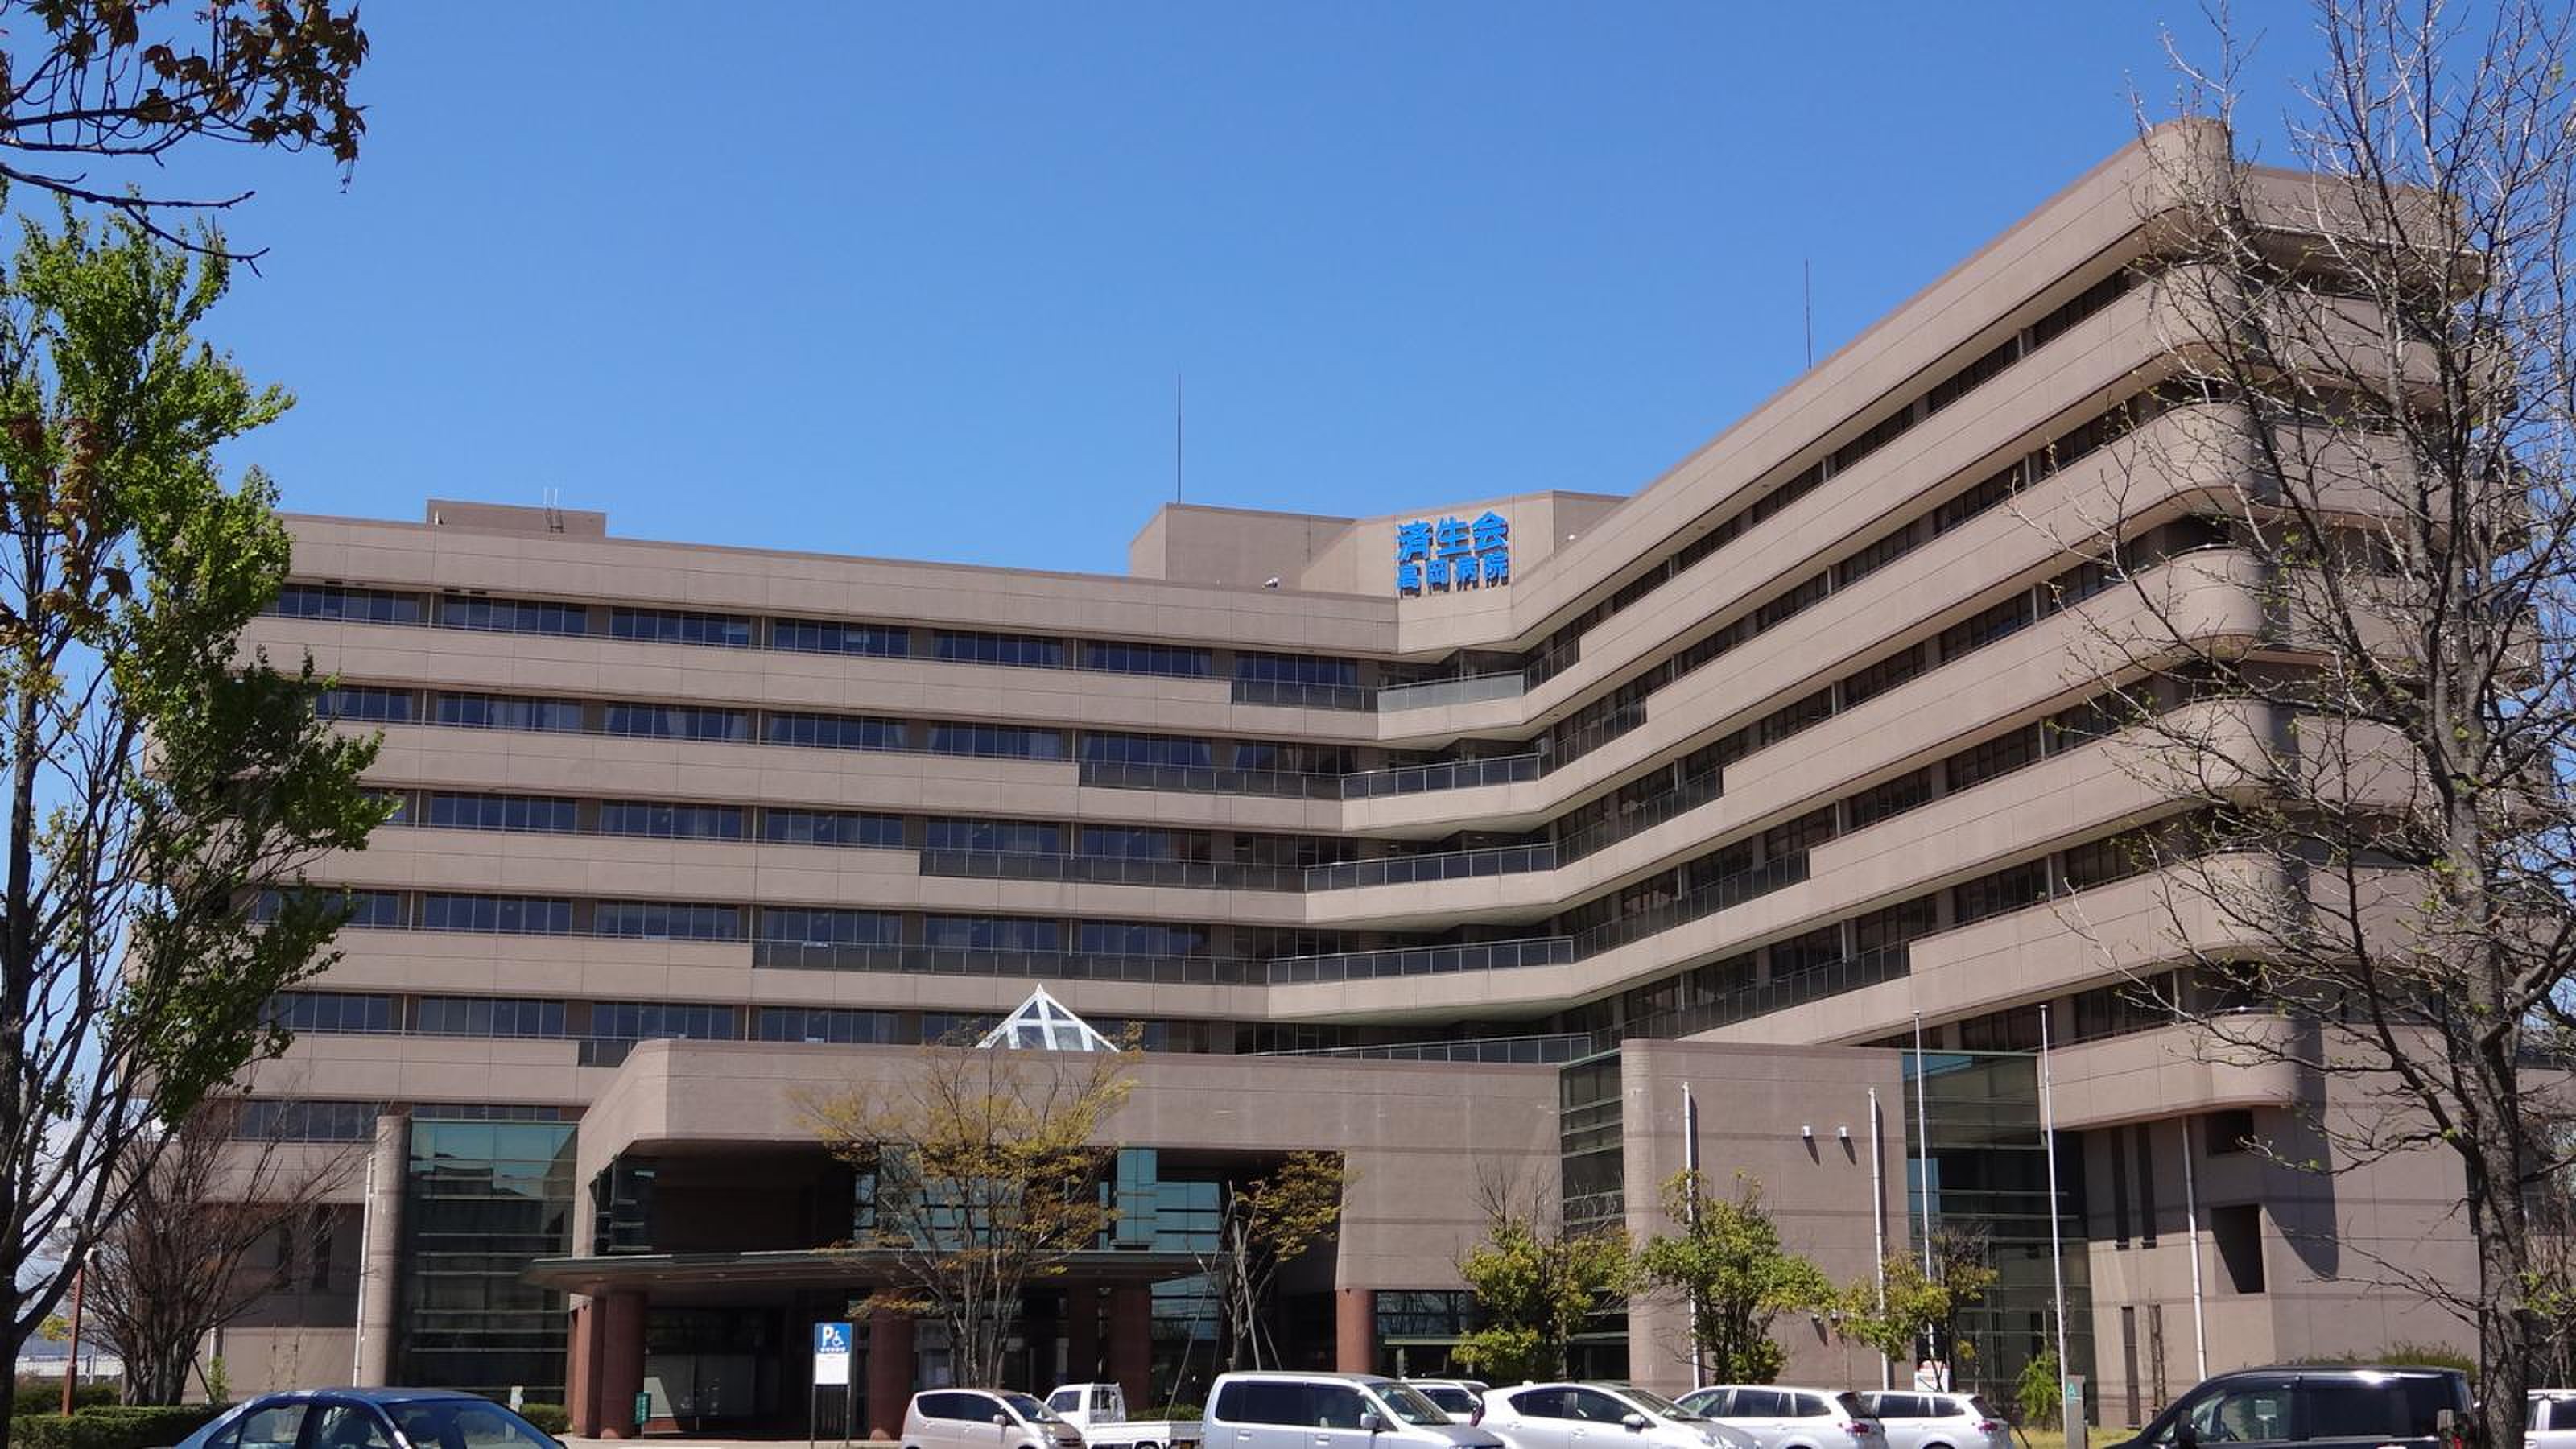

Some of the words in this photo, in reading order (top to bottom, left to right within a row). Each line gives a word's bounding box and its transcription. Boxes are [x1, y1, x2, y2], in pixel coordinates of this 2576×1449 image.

[1397, 511, 1508, 560] 済生会
[823, 1325, 834, 1347] P
